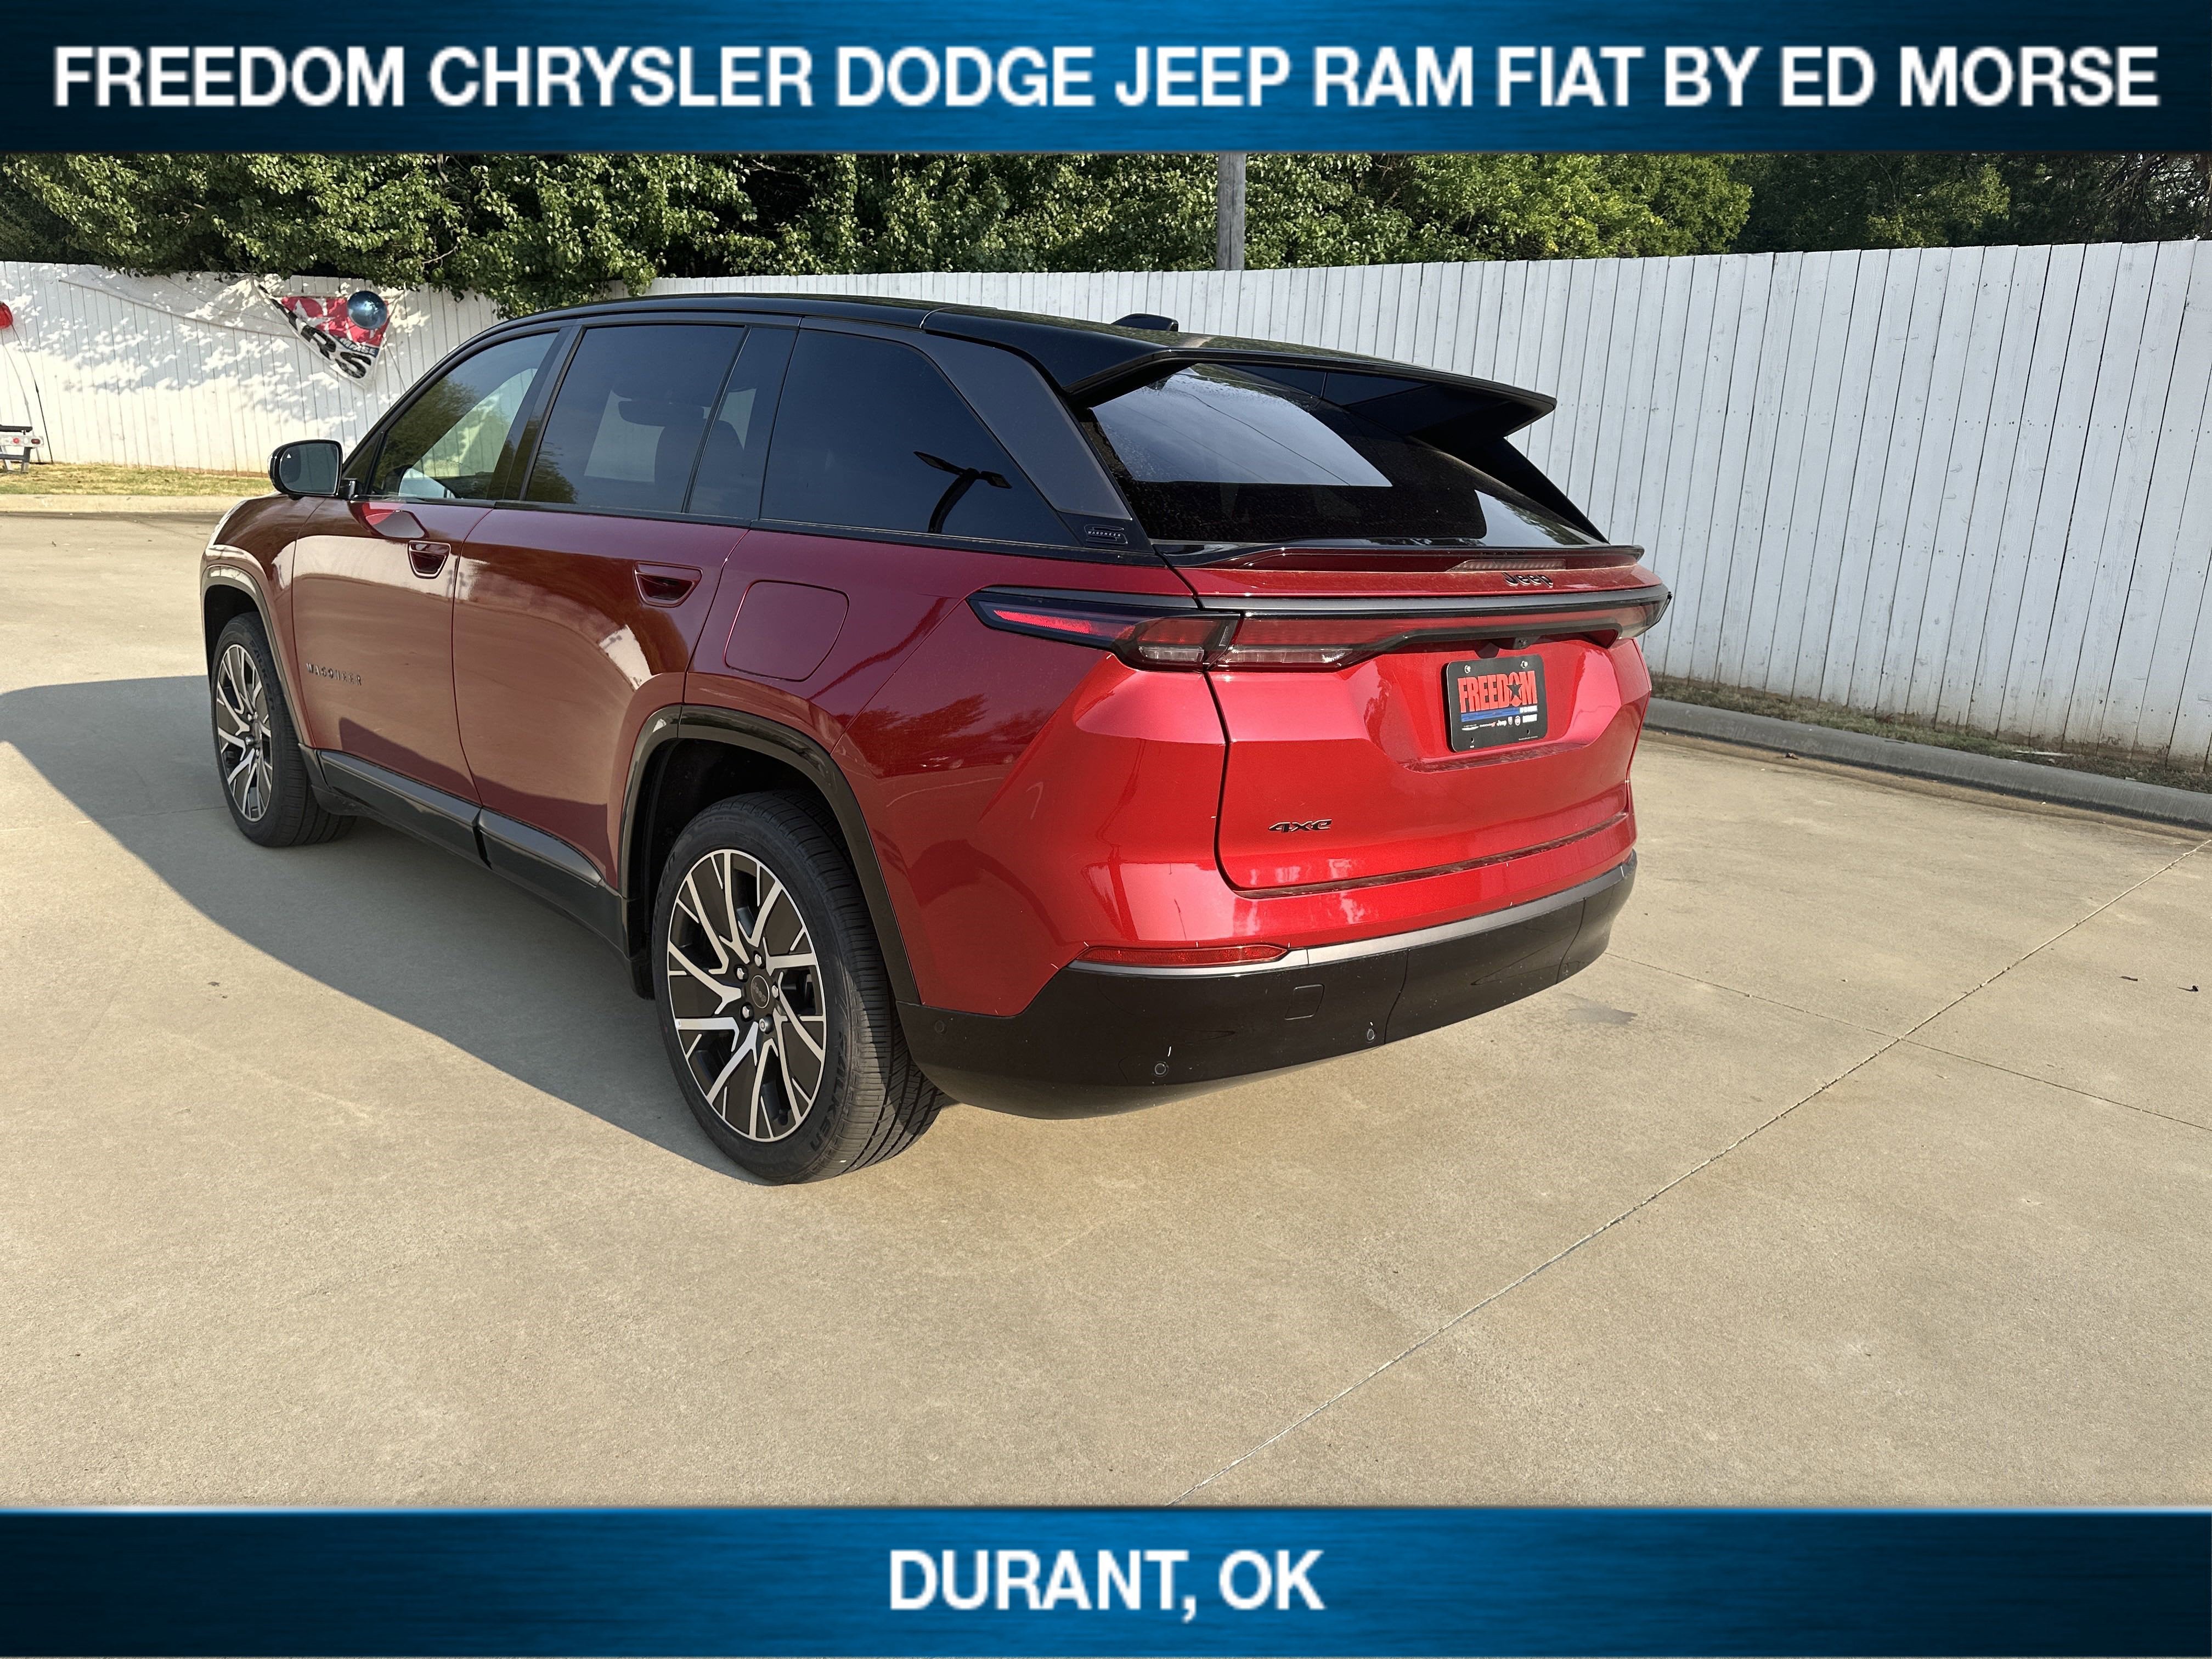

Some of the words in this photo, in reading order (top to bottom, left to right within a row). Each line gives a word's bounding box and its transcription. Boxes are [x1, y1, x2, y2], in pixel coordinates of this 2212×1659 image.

[1501, 571, 1554, 589] Jeep
[306, 662, 362, 686] WAGONEER
[1457, 670, 1538, 713] FREEDOM
